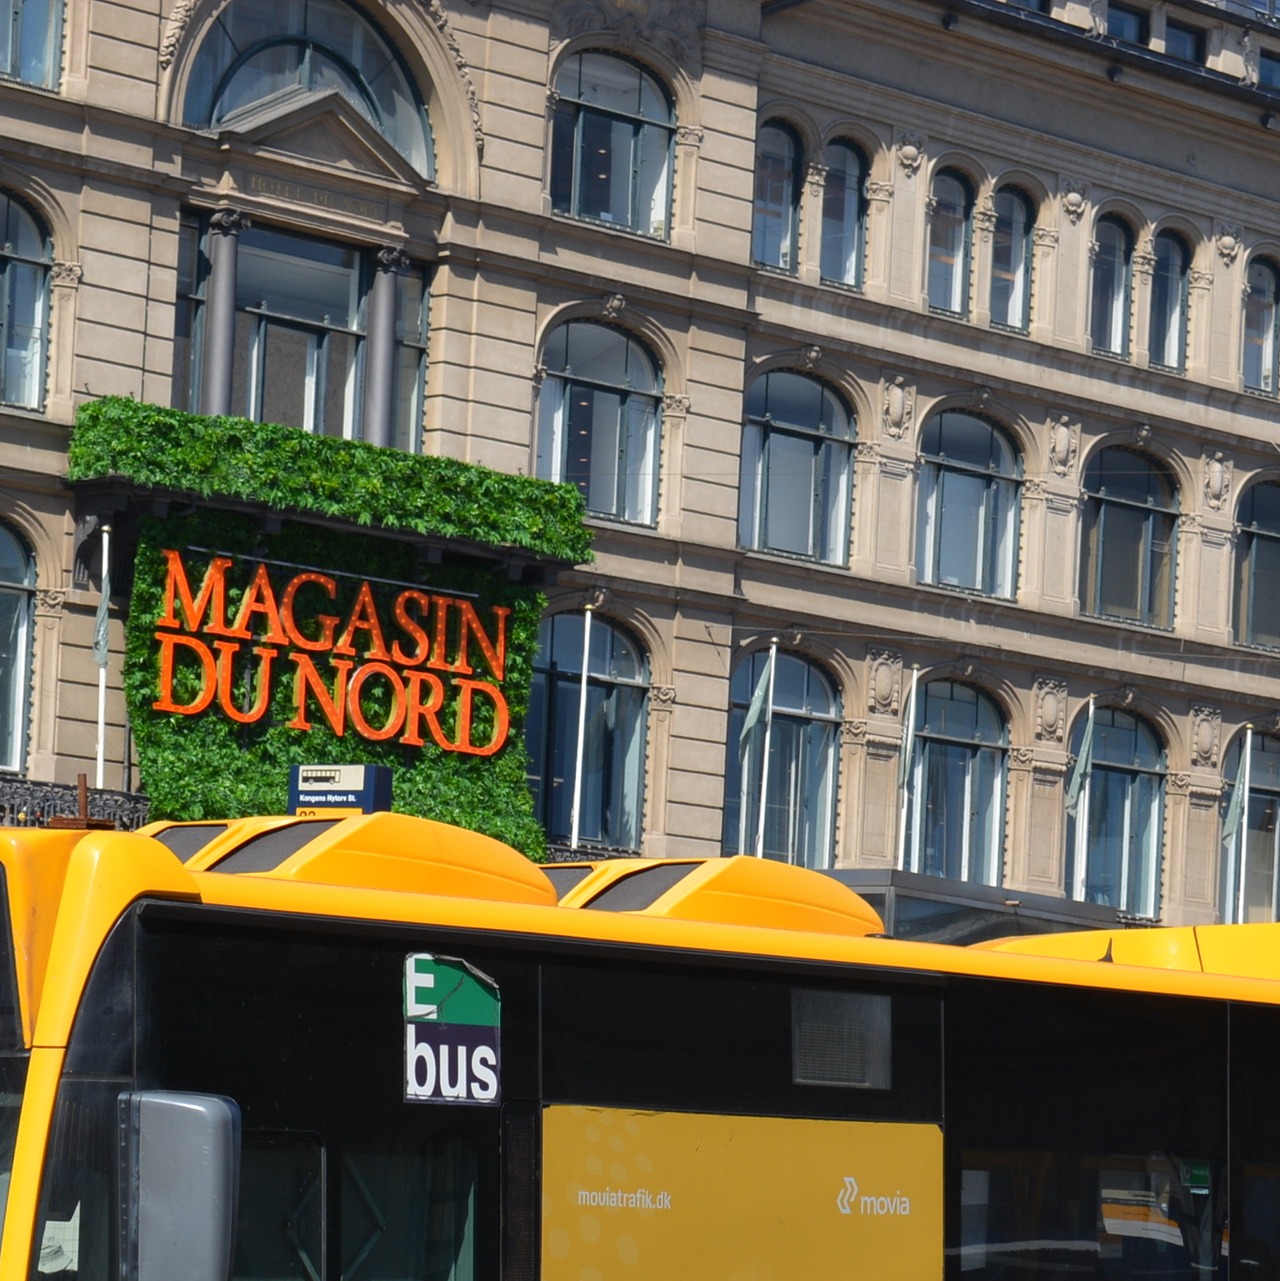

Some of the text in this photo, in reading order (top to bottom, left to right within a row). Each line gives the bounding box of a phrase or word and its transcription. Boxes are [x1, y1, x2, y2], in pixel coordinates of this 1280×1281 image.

[155, 549, 511, 681] MAGASIN
[153, 632, 510, 757] DU NORD
[299, 794, 326, 803] Kongens
[327, 794, 347, 803] Nytorv
[406, 953, 437, 1020] E
[406, 1024, 498, 1102] bus
[578, 1187, 671, 1210] moviatrafik.dk
[861, 1190, 910, 1215] movia
